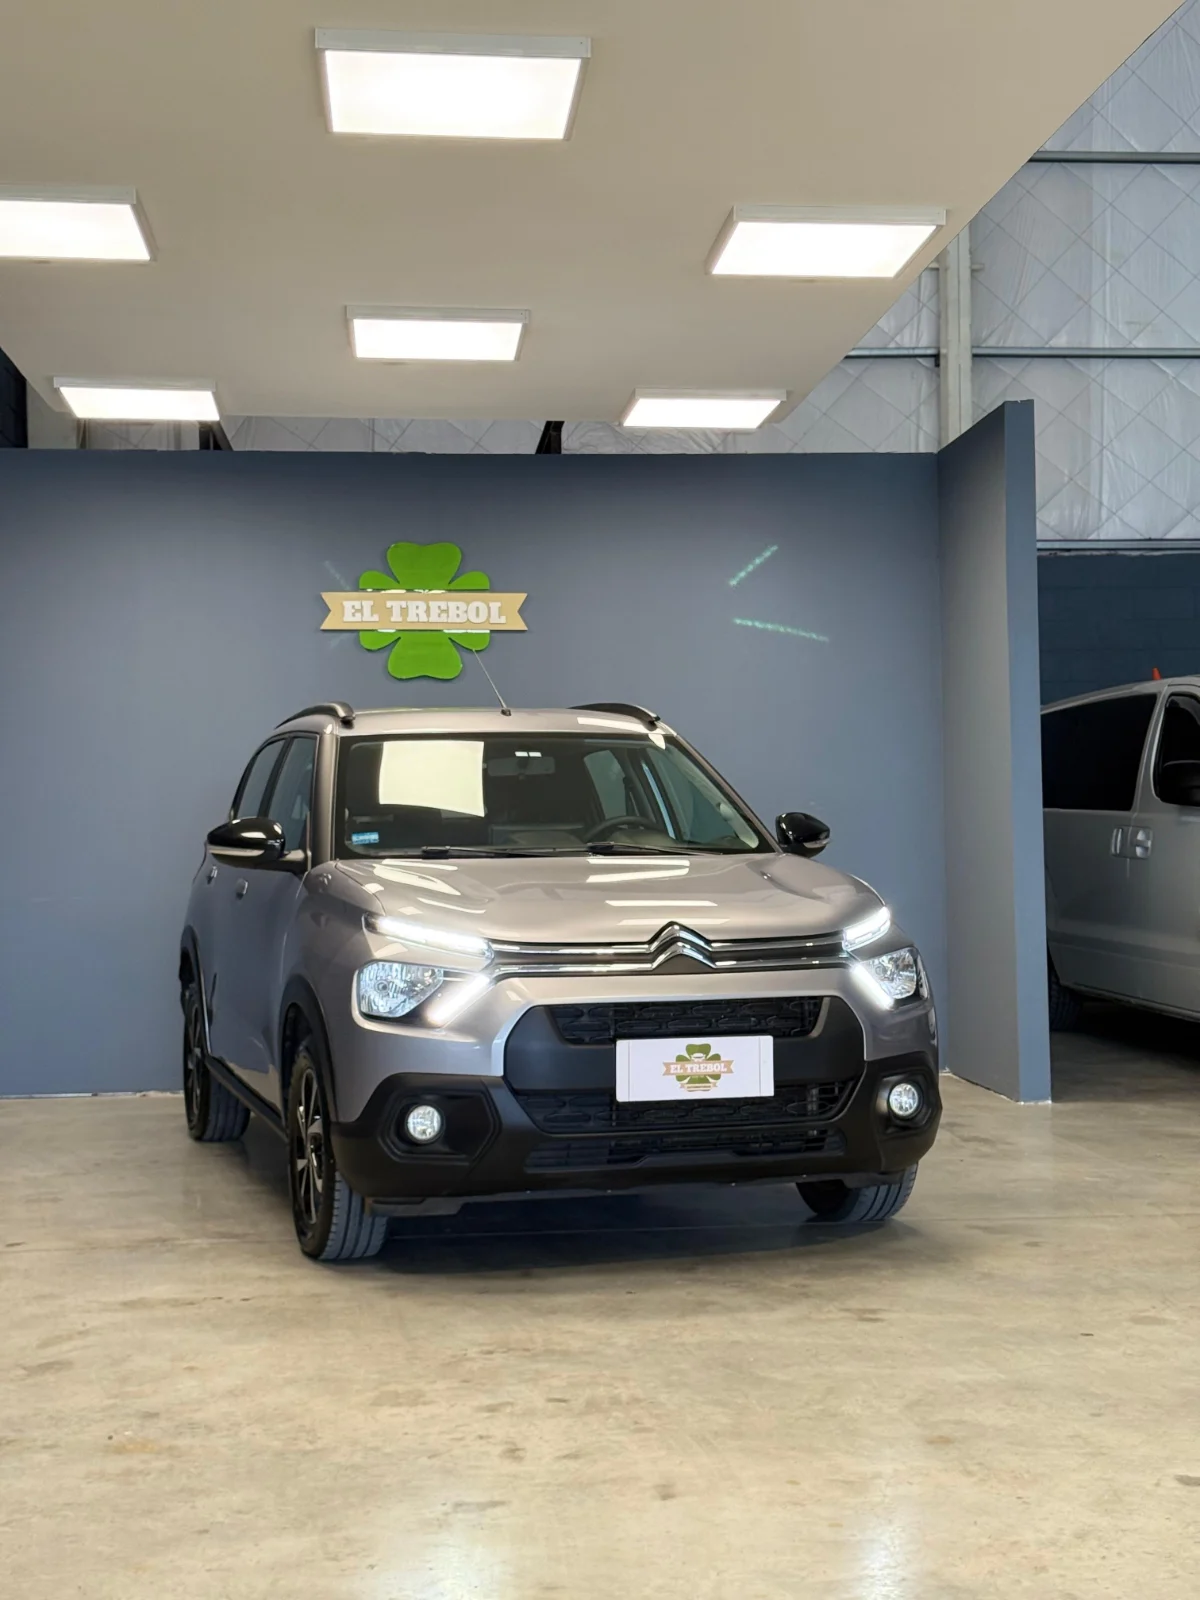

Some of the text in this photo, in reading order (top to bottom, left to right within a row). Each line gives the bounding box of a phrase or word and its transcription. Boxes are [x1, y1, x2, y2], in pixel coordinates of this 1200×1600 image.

[342, 600, 507, 624] EL TREBOL
[670, 1063, 727, 1074] EL TREBOL
